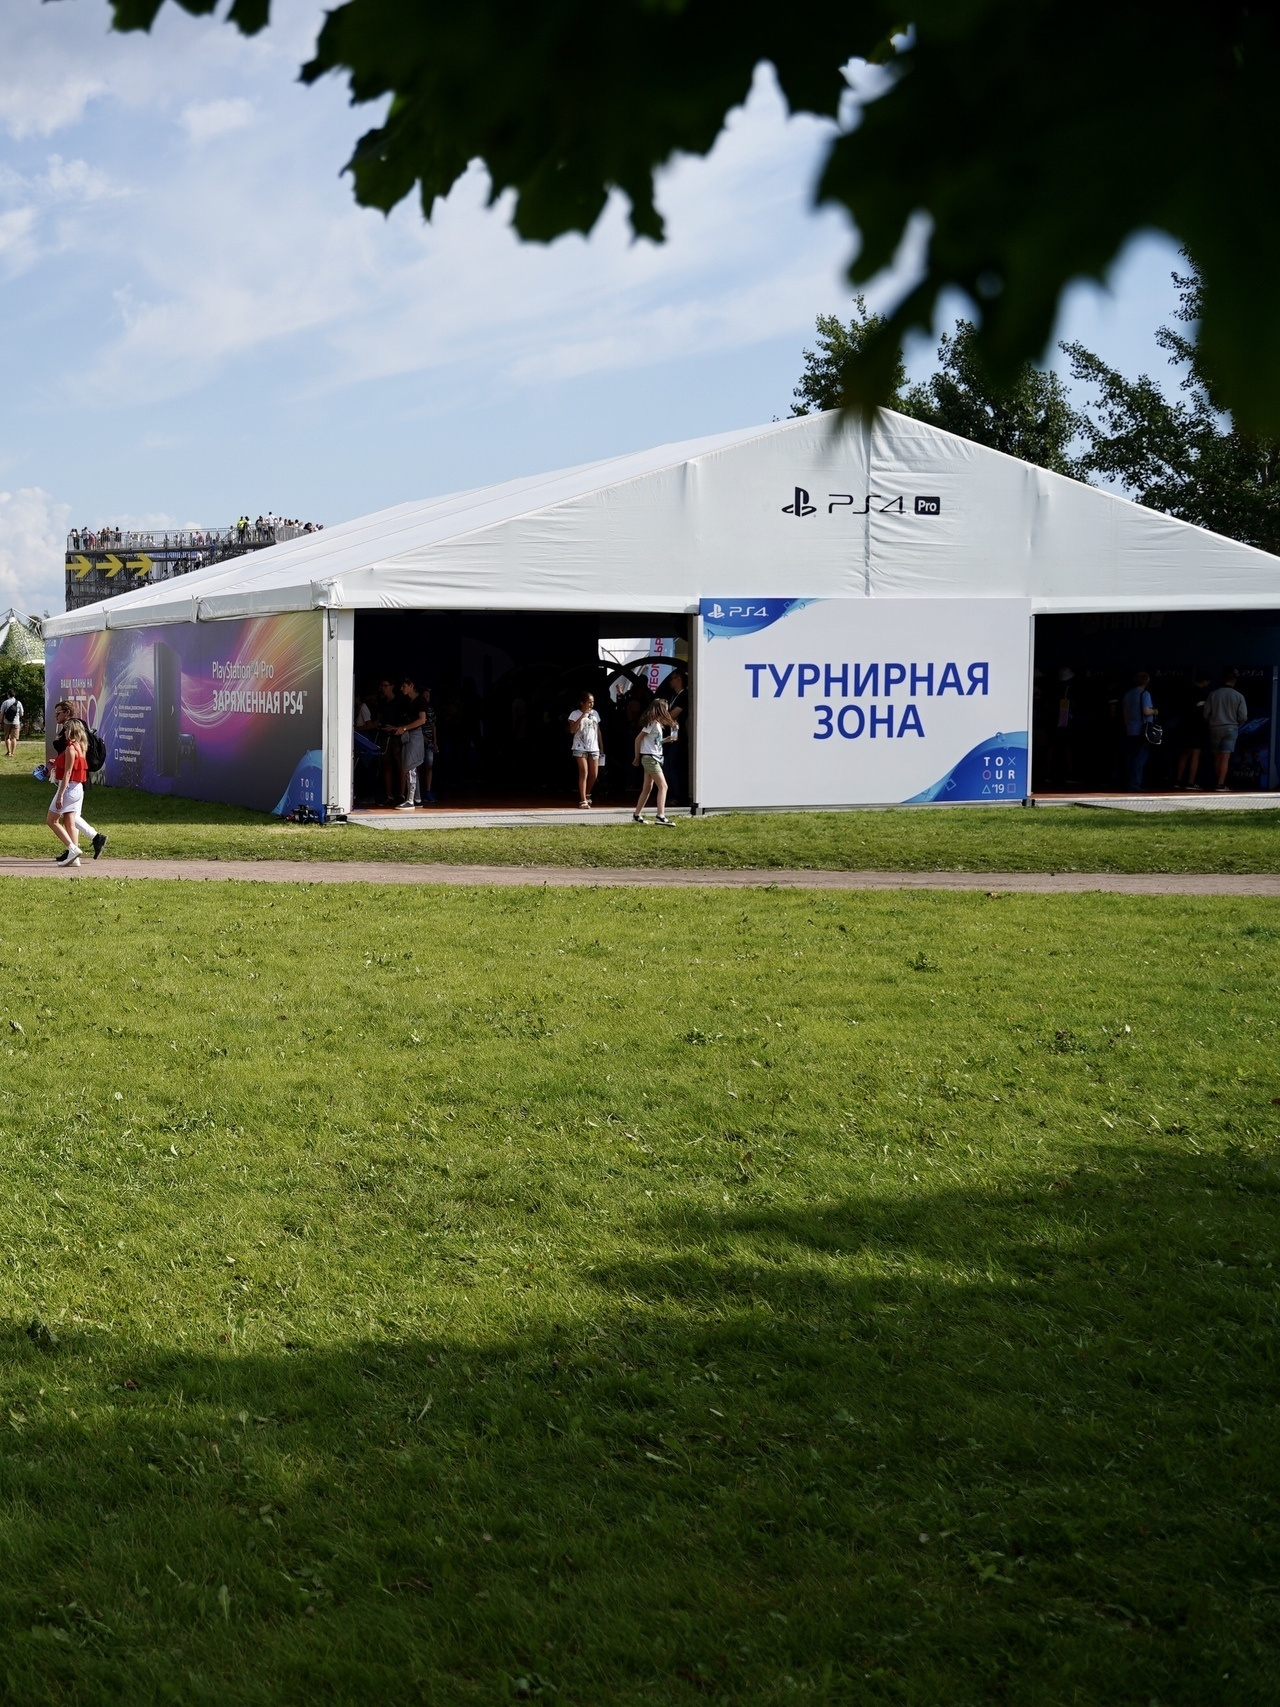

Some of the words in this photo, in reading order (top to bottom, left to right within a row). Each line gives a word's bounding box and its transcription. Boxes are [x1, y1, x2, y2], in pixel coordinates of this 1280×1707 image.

[828, 494, 907, 514] PS4
[917, 499, 937, 512] Pro
[729, 606, 767, 617] PS4
[261, 660, 274, 679] Pro
[744, 662, 989, 698] ТУРНИРНАЯ
[212, 689, 280, 714] ЗАРЯЖЕННАЯ
[813, 704, 925, 740] ЗОНА
